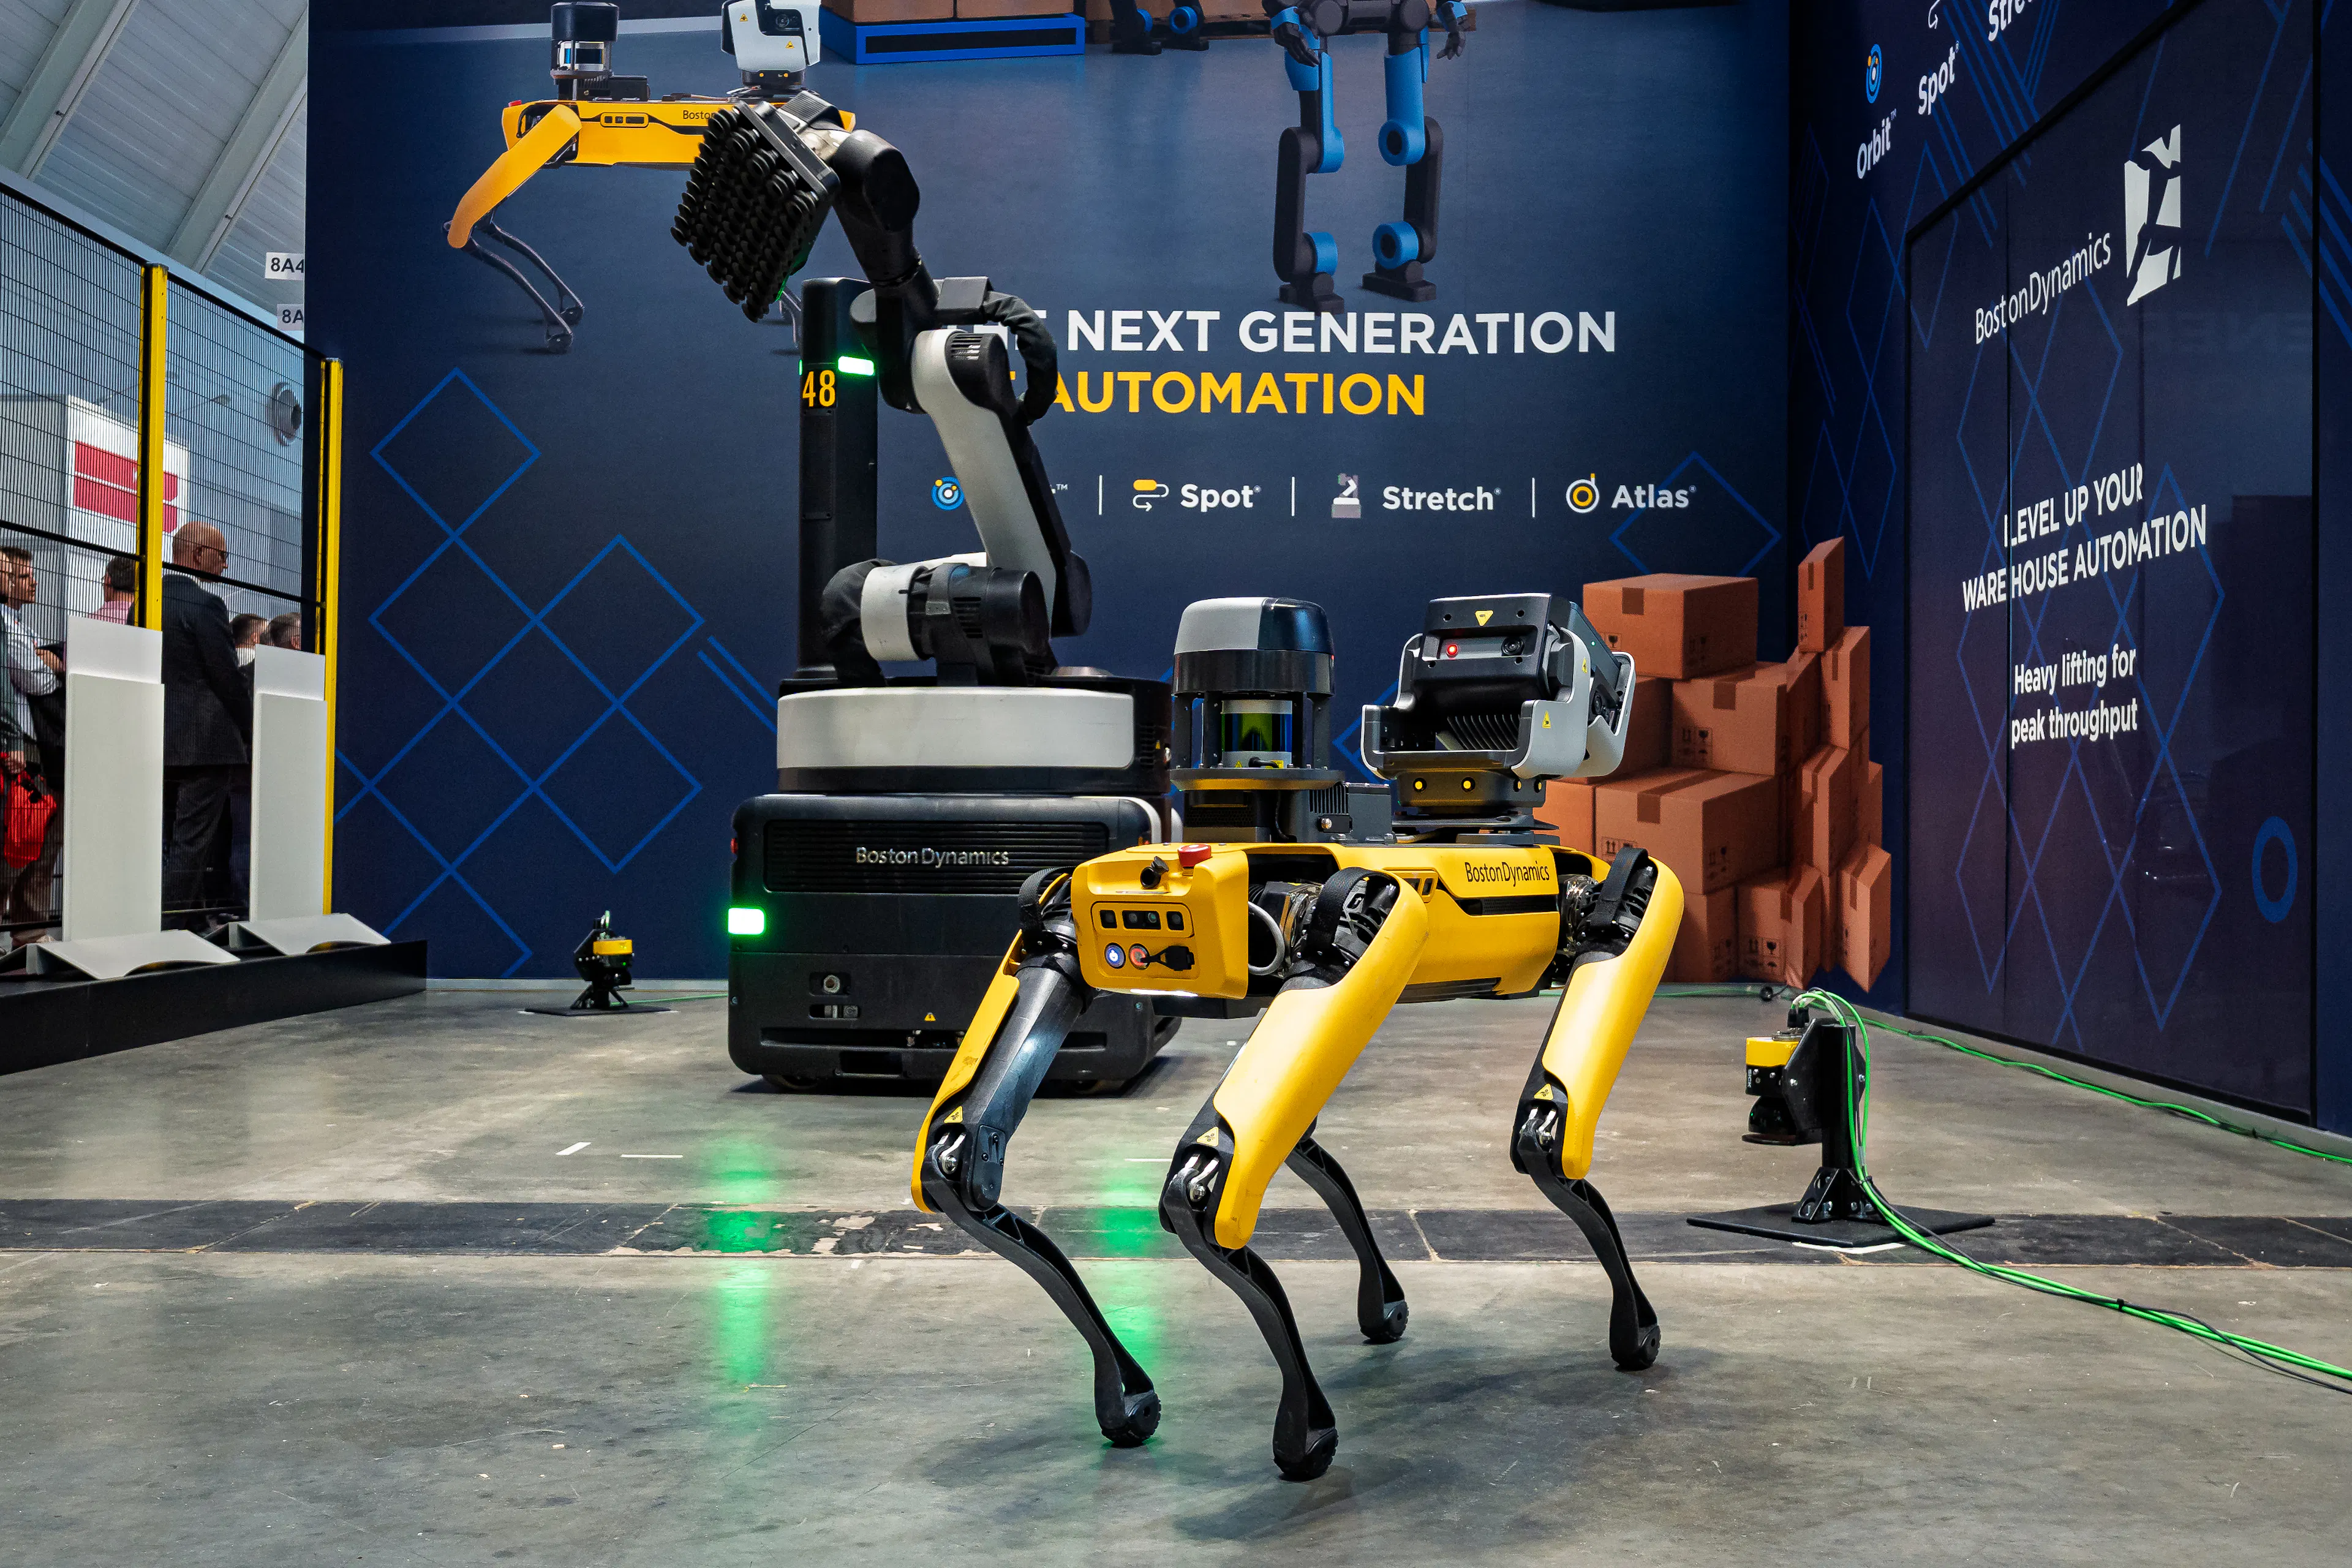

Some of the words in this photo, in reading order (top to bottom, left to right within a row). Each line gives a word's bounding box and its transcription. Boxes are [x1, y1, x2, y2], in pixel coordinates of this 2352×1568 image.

[1068, 309, 1221, 352] NEXT
[1238, 310, 1615, 354] GENERATION
[802, 370, 835, 407] 48
[2003, 497, 2060, 547] LEVEL
[2064, 485, 2089, 526] UP
[2093, 462, 2143, 515] YOUR
[2073, 504, 2206, 581] AUTOMATION
[2015, 663, 2058, 695] Heavy
[2062, 650, 2108, 688] lifting
[2111, 643, 2136, 679] for
[2011, 709, 2045, 750] peak
[2049, 698, 2138, 742] throughput
